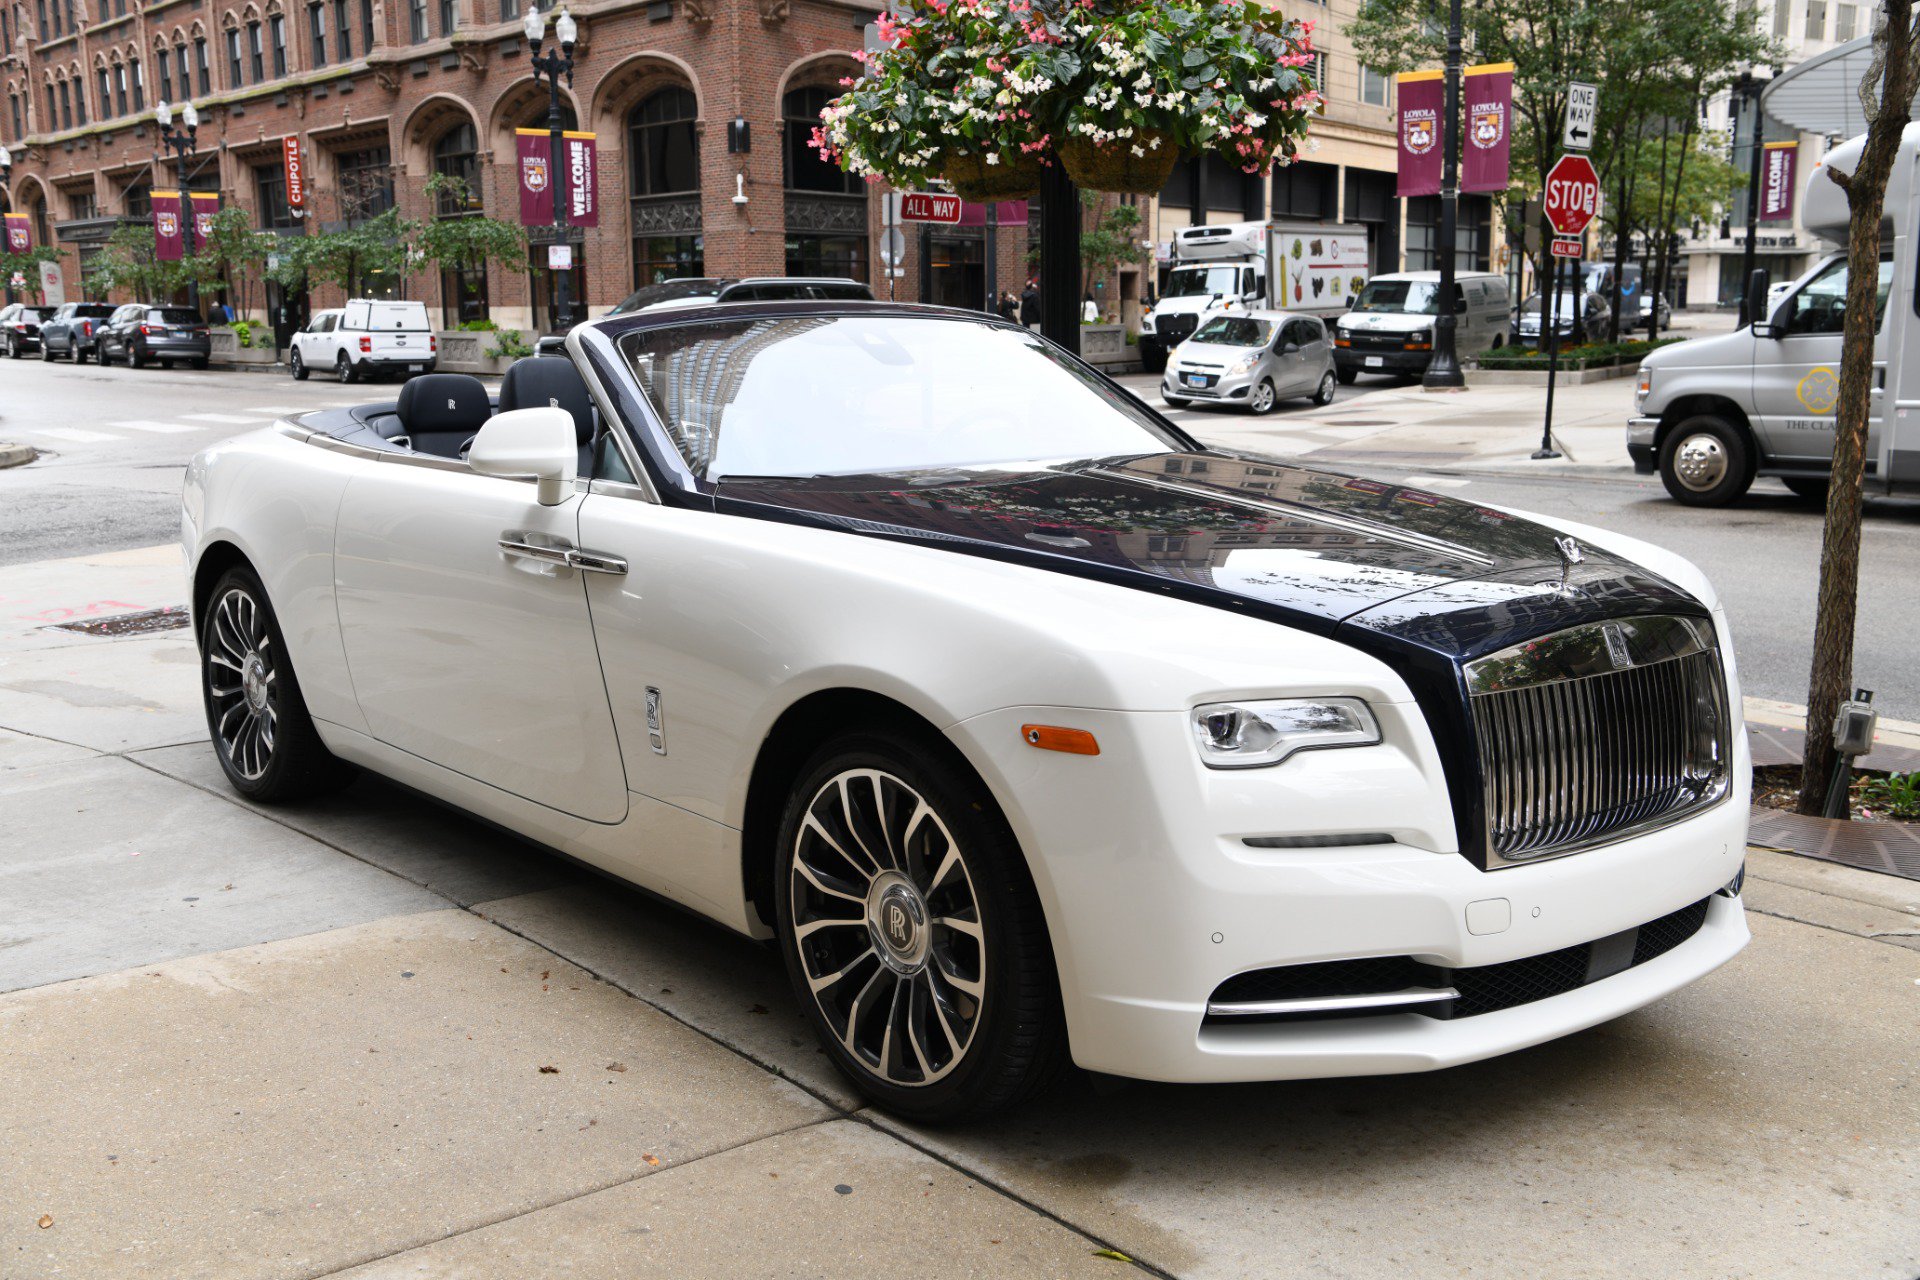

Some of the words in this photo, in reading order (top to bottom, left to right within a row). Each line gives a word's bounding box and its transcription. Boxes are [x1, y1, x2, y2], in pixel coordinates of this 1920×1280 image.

[1572, 89, 1593, 106] ONE
[1403, 109, 1436, 119] LOYOLA
[1471, 102, 1504, 112] LOYOLA
[1570, 106, 1591, 123] WAY
[287, 140, 301, 203] CHIPOTLE
[570, 141, 585, 217] WELCOME
[1766, 150, 1783, 214] WELCOME
[1548, 179, 1595, 212] STOP
[906, 198, 928, 216] ALL
[933, 200, 956, 218] WAY
[1554, 243, 1567, 253] ALL
[1567, 244, 1580, 254] WAY
[1785, 420, 1808, 430] THE
